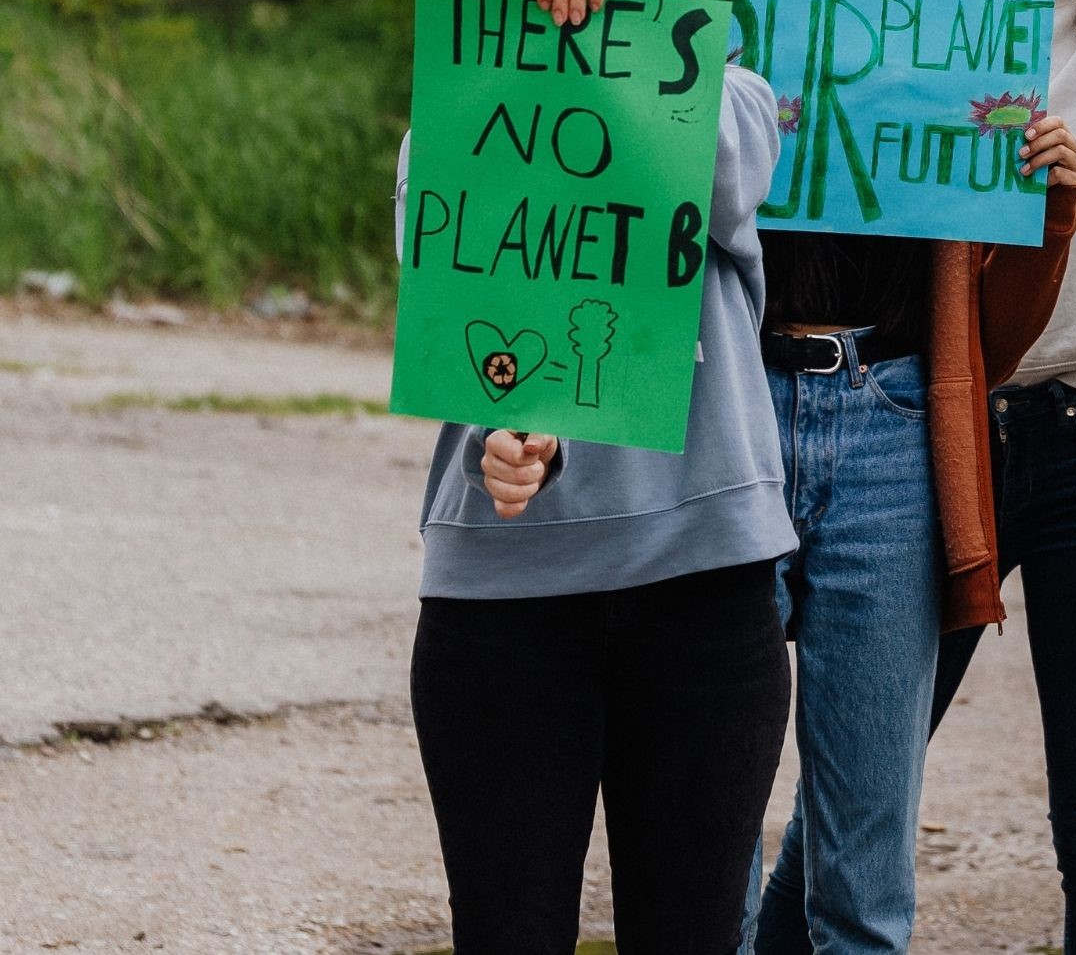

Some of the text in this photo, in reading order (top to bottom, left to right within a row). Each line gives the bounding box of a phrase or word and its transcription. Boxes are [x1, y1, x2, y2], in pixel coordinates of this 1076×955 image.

[472, 101, 613, 179] NO
[411, 189, 705, 288] PLANET B
